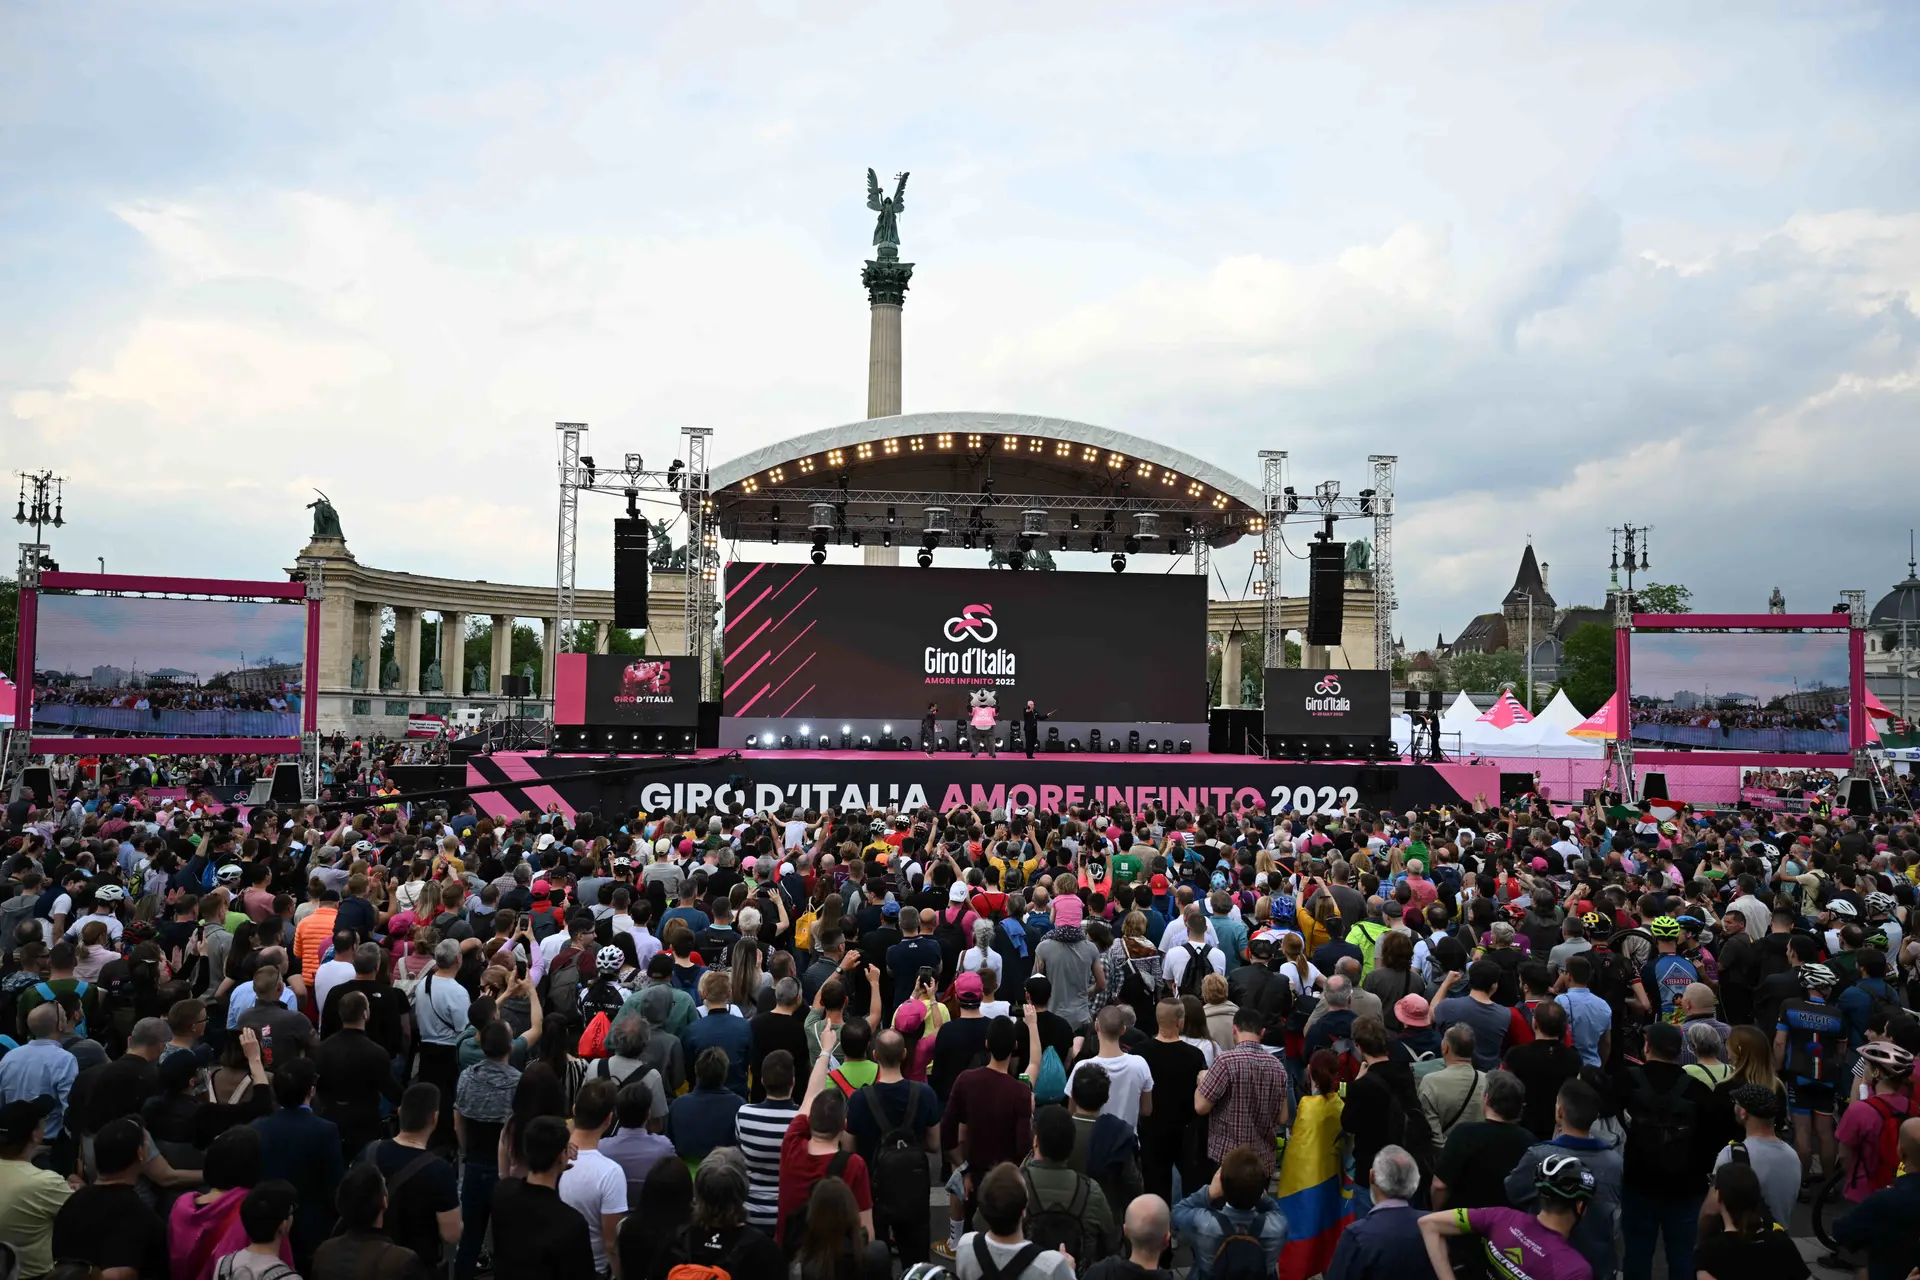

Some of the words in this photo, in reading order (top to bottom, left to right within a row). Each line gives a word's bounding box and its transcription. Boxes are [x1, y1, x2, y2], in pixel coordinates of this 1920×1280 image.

[925, 646, 959, 674] Giro
[961, 647, 1015, 675] d'Italia
[957, 677, 994, 685] INFINITO
[613, 695, 635, 703] GIRO
[1305, 696, 1322, 711] Giro
[1323, 697, 1350, 711] d'Italia
[641, 783, 746, 814] GIRO
[756, 783, 930, 814] D'ITALIA
[939, 784, 1085, 815] AMORE
[1095, 785, 1262, 816] INFINITO
[1271, 786, 1362, 816] 2022
